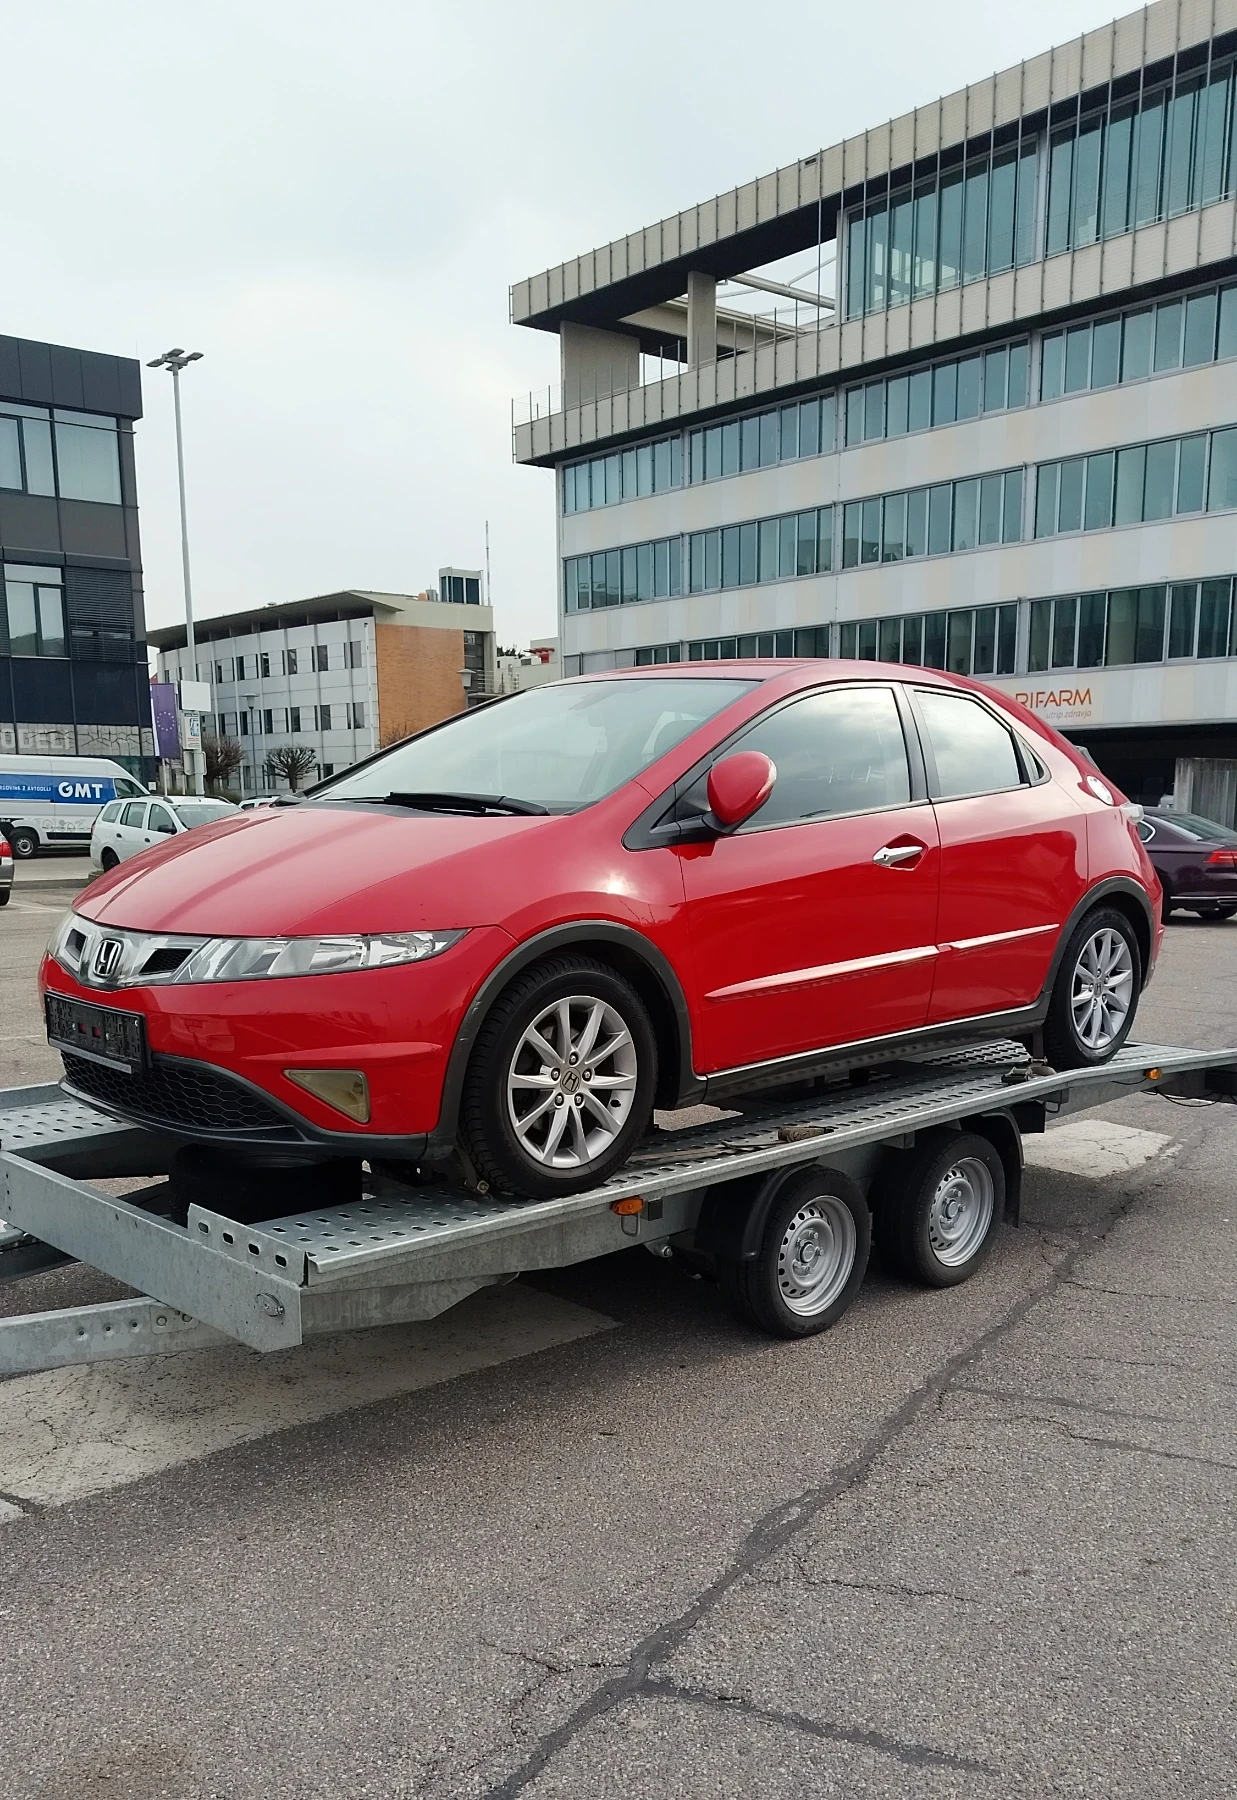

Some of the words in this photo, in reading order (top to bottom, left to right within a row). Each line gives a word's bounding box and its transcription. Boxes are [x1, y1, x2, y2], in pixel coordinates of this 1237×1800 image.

[1016, 688, 1092, 708] RIFARM
[1046, 710, 1063, 720] utrip
[1064, 708, 1092, 719] zdravja
[58, 781, 103, 798] GMT
